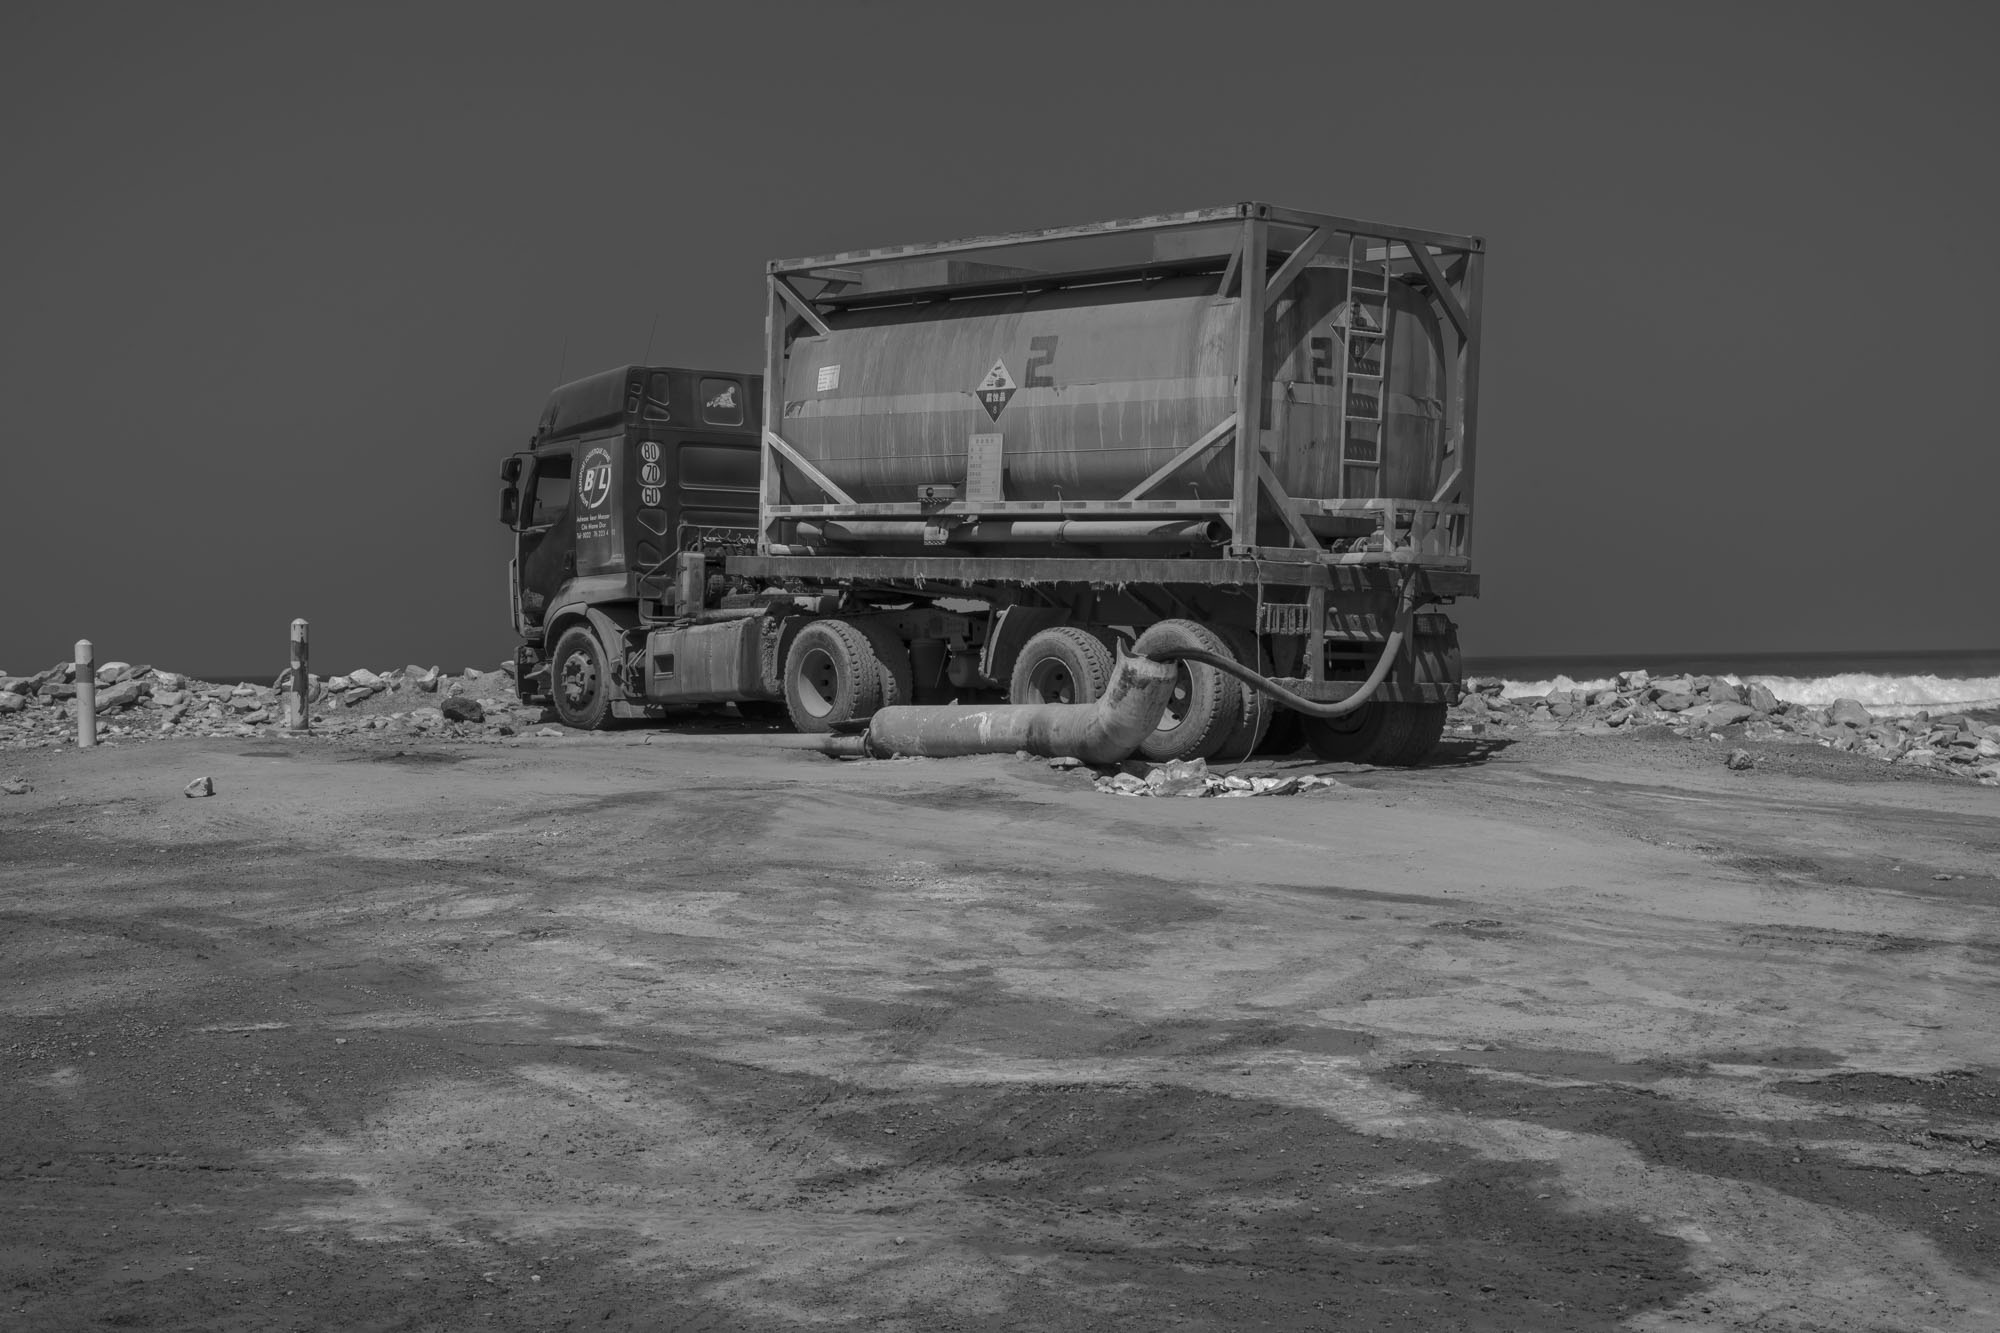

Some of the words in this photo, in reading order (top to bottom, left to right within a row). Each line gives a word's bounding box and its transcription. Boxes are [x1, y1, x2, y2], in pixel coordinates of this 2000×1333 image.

[1024, 335, 1059, 389] 2
[1310, 336, 1334, 386] 2
[644, 443, 657, 460] 80
[646, 464, 658, 481] 70
[644, 487, 658, 504] 60
